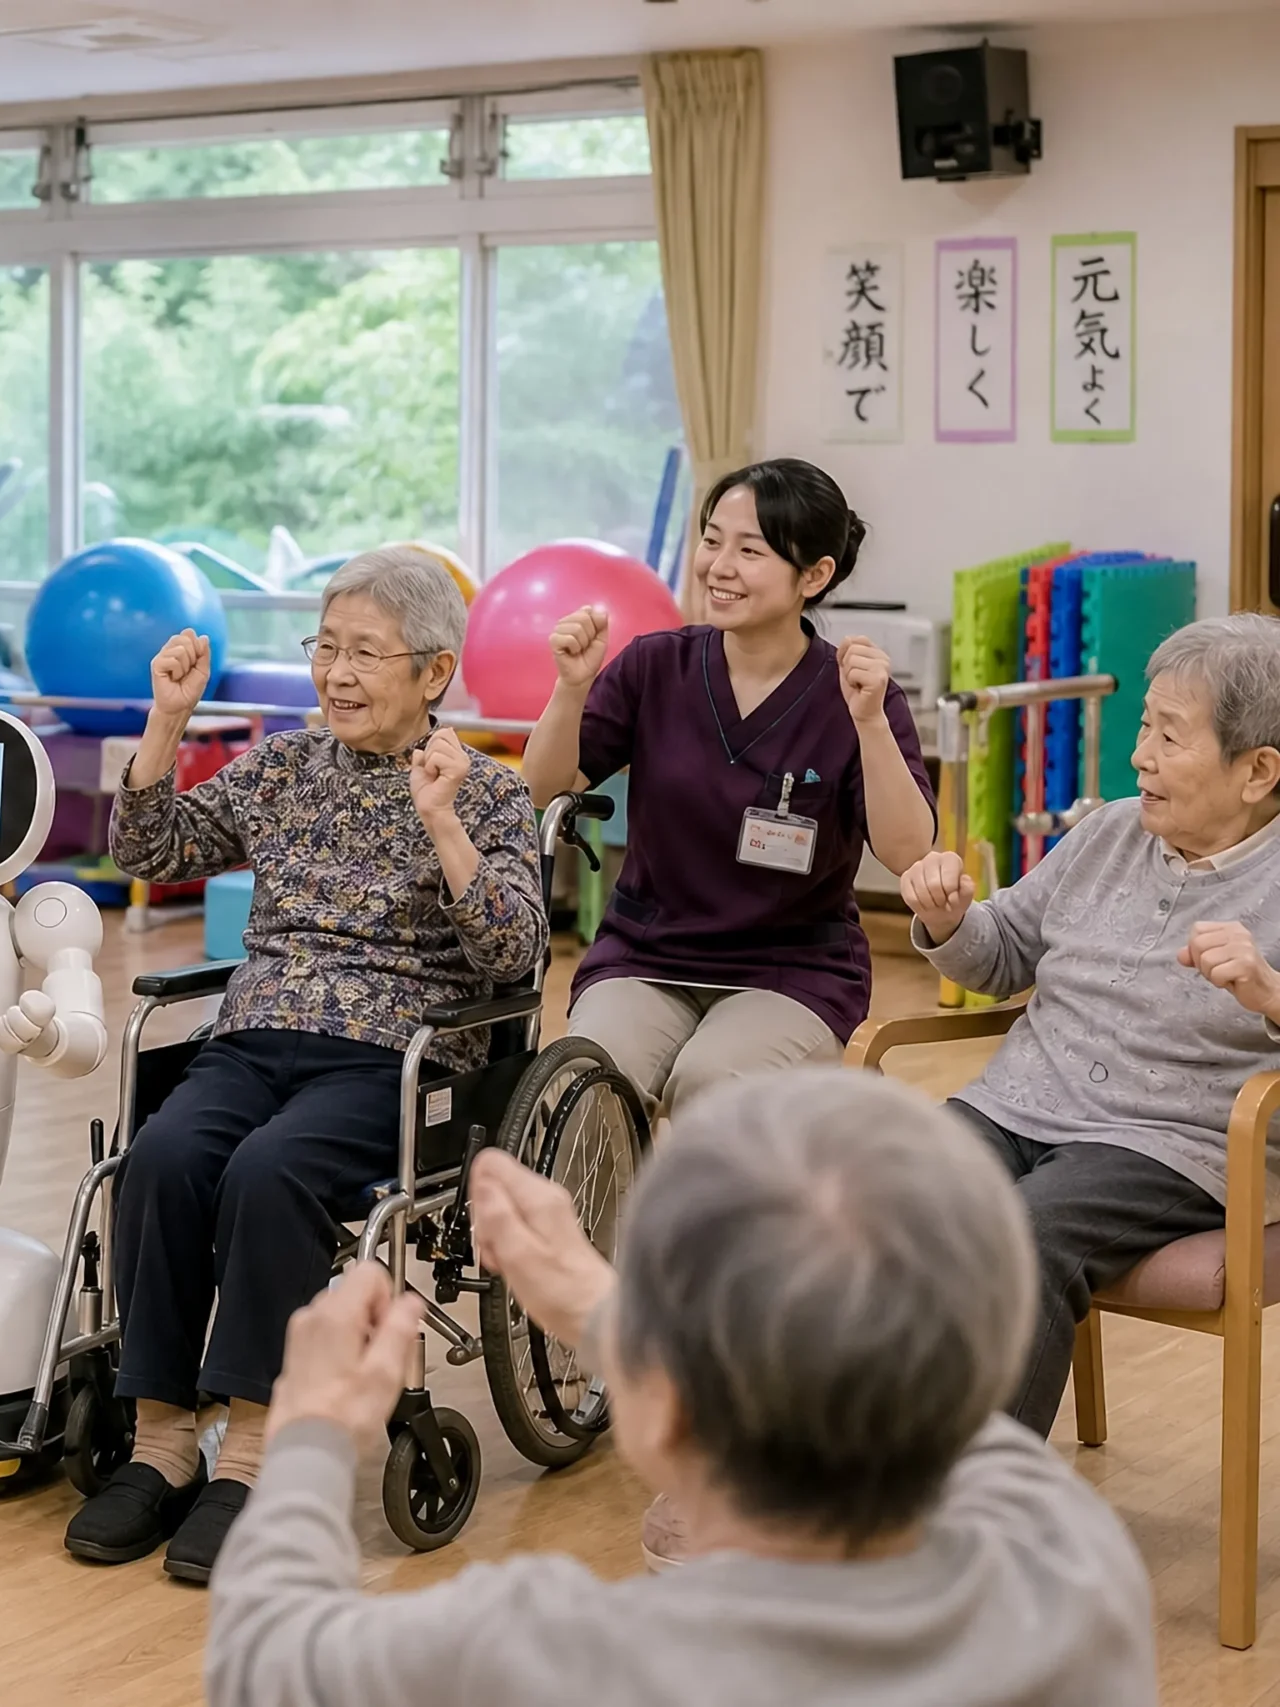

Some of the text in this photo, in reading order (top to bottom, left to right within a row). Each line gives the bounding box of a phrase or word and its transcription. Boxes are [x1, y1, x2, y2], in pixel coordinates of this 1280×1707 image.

[838, 260, 888, 423] 笑顔で
[955, 259, 998, 409] 楽しく
[1072, 256, 1120, 425] 元気よく
